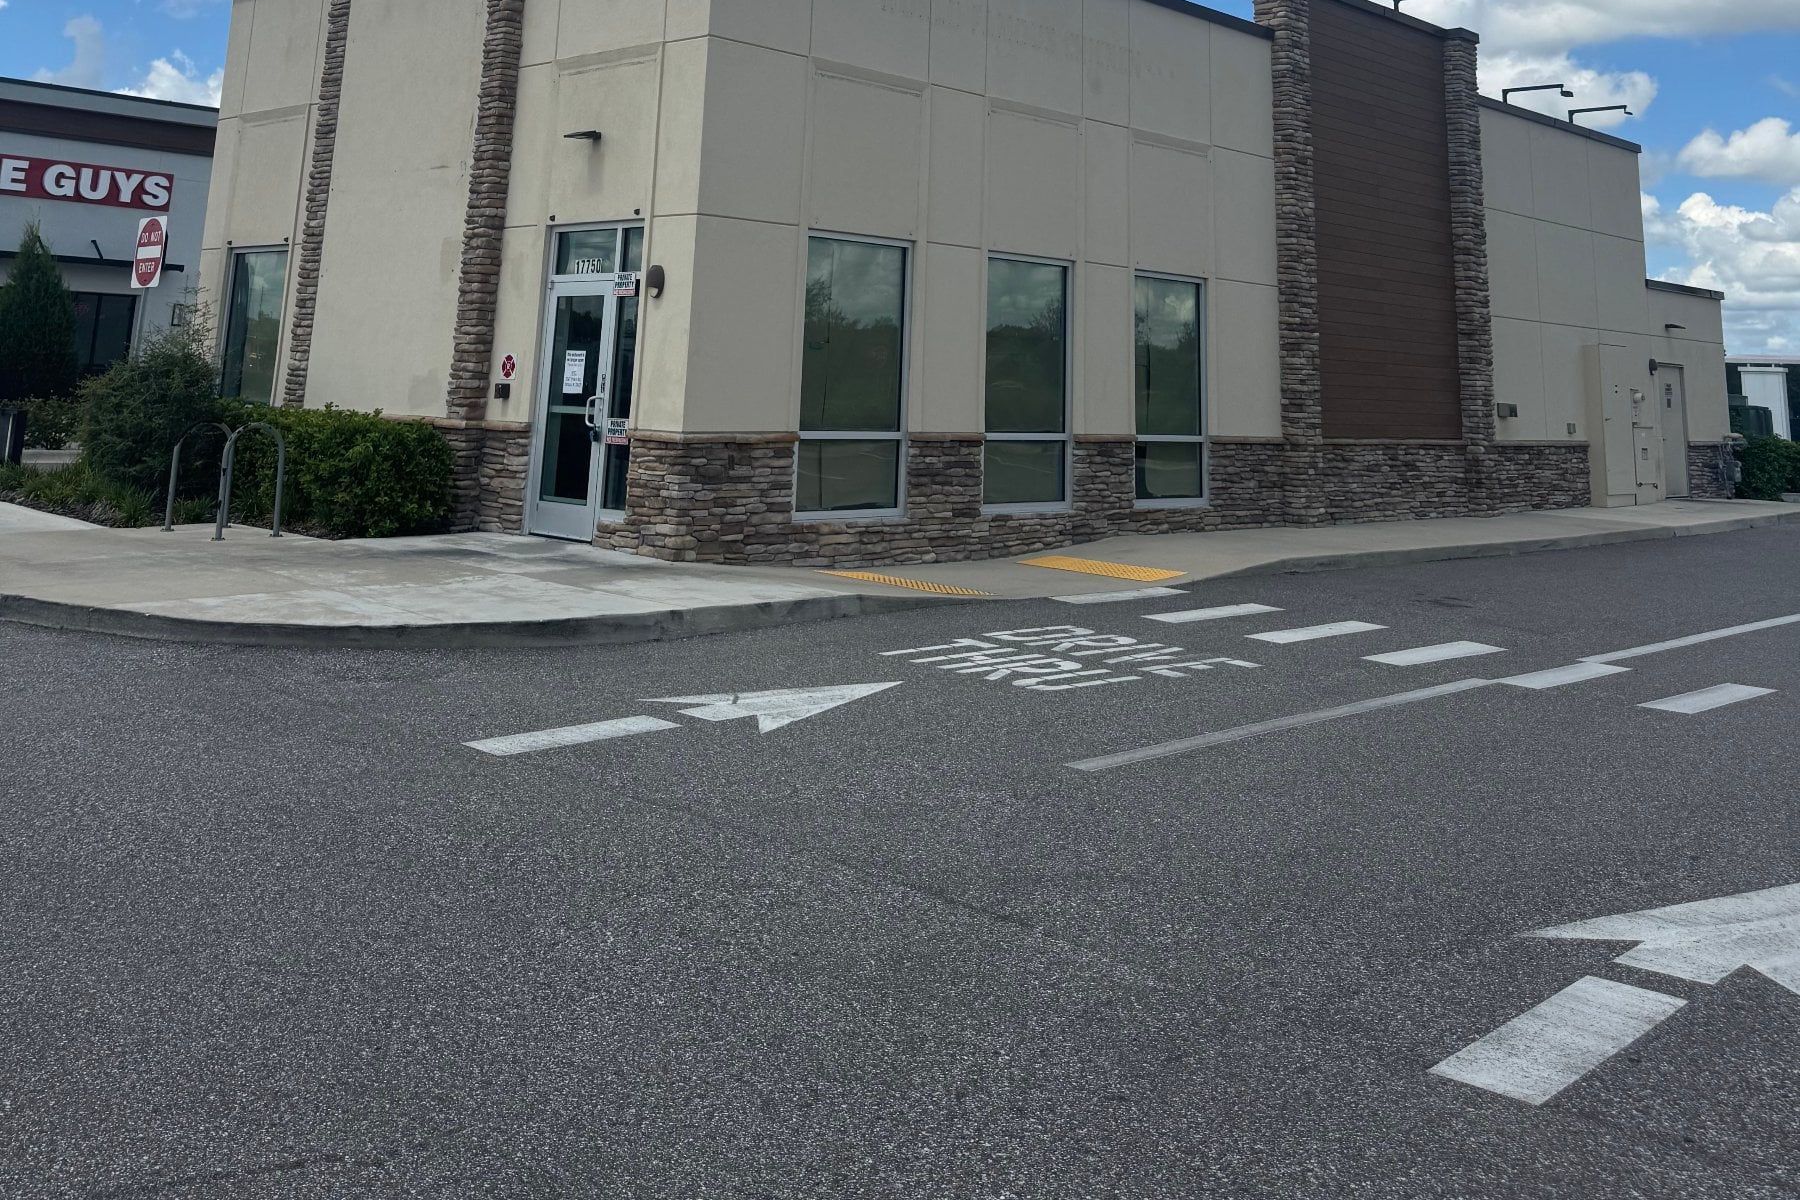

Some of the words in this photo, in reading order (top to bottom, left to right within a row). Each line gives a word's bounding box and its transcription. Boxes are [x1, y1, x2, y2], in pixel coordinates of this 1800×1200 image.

[0, 158, 30, 192] E
[42, 163, 170, 207] GUYS
[140, 232, 149, 243] DO
[150, 230, 162, 243] NOT
[138, 262, 155, 274] ENTER
[576, 258, 602, 274] 17750
[617, 273, 633, 281] PRIVATE
[610, 420, 626, 428] PRIVATE
[981, 625, 1264, 678] DRIVE
[877, 638, 1143, 690] THRU
